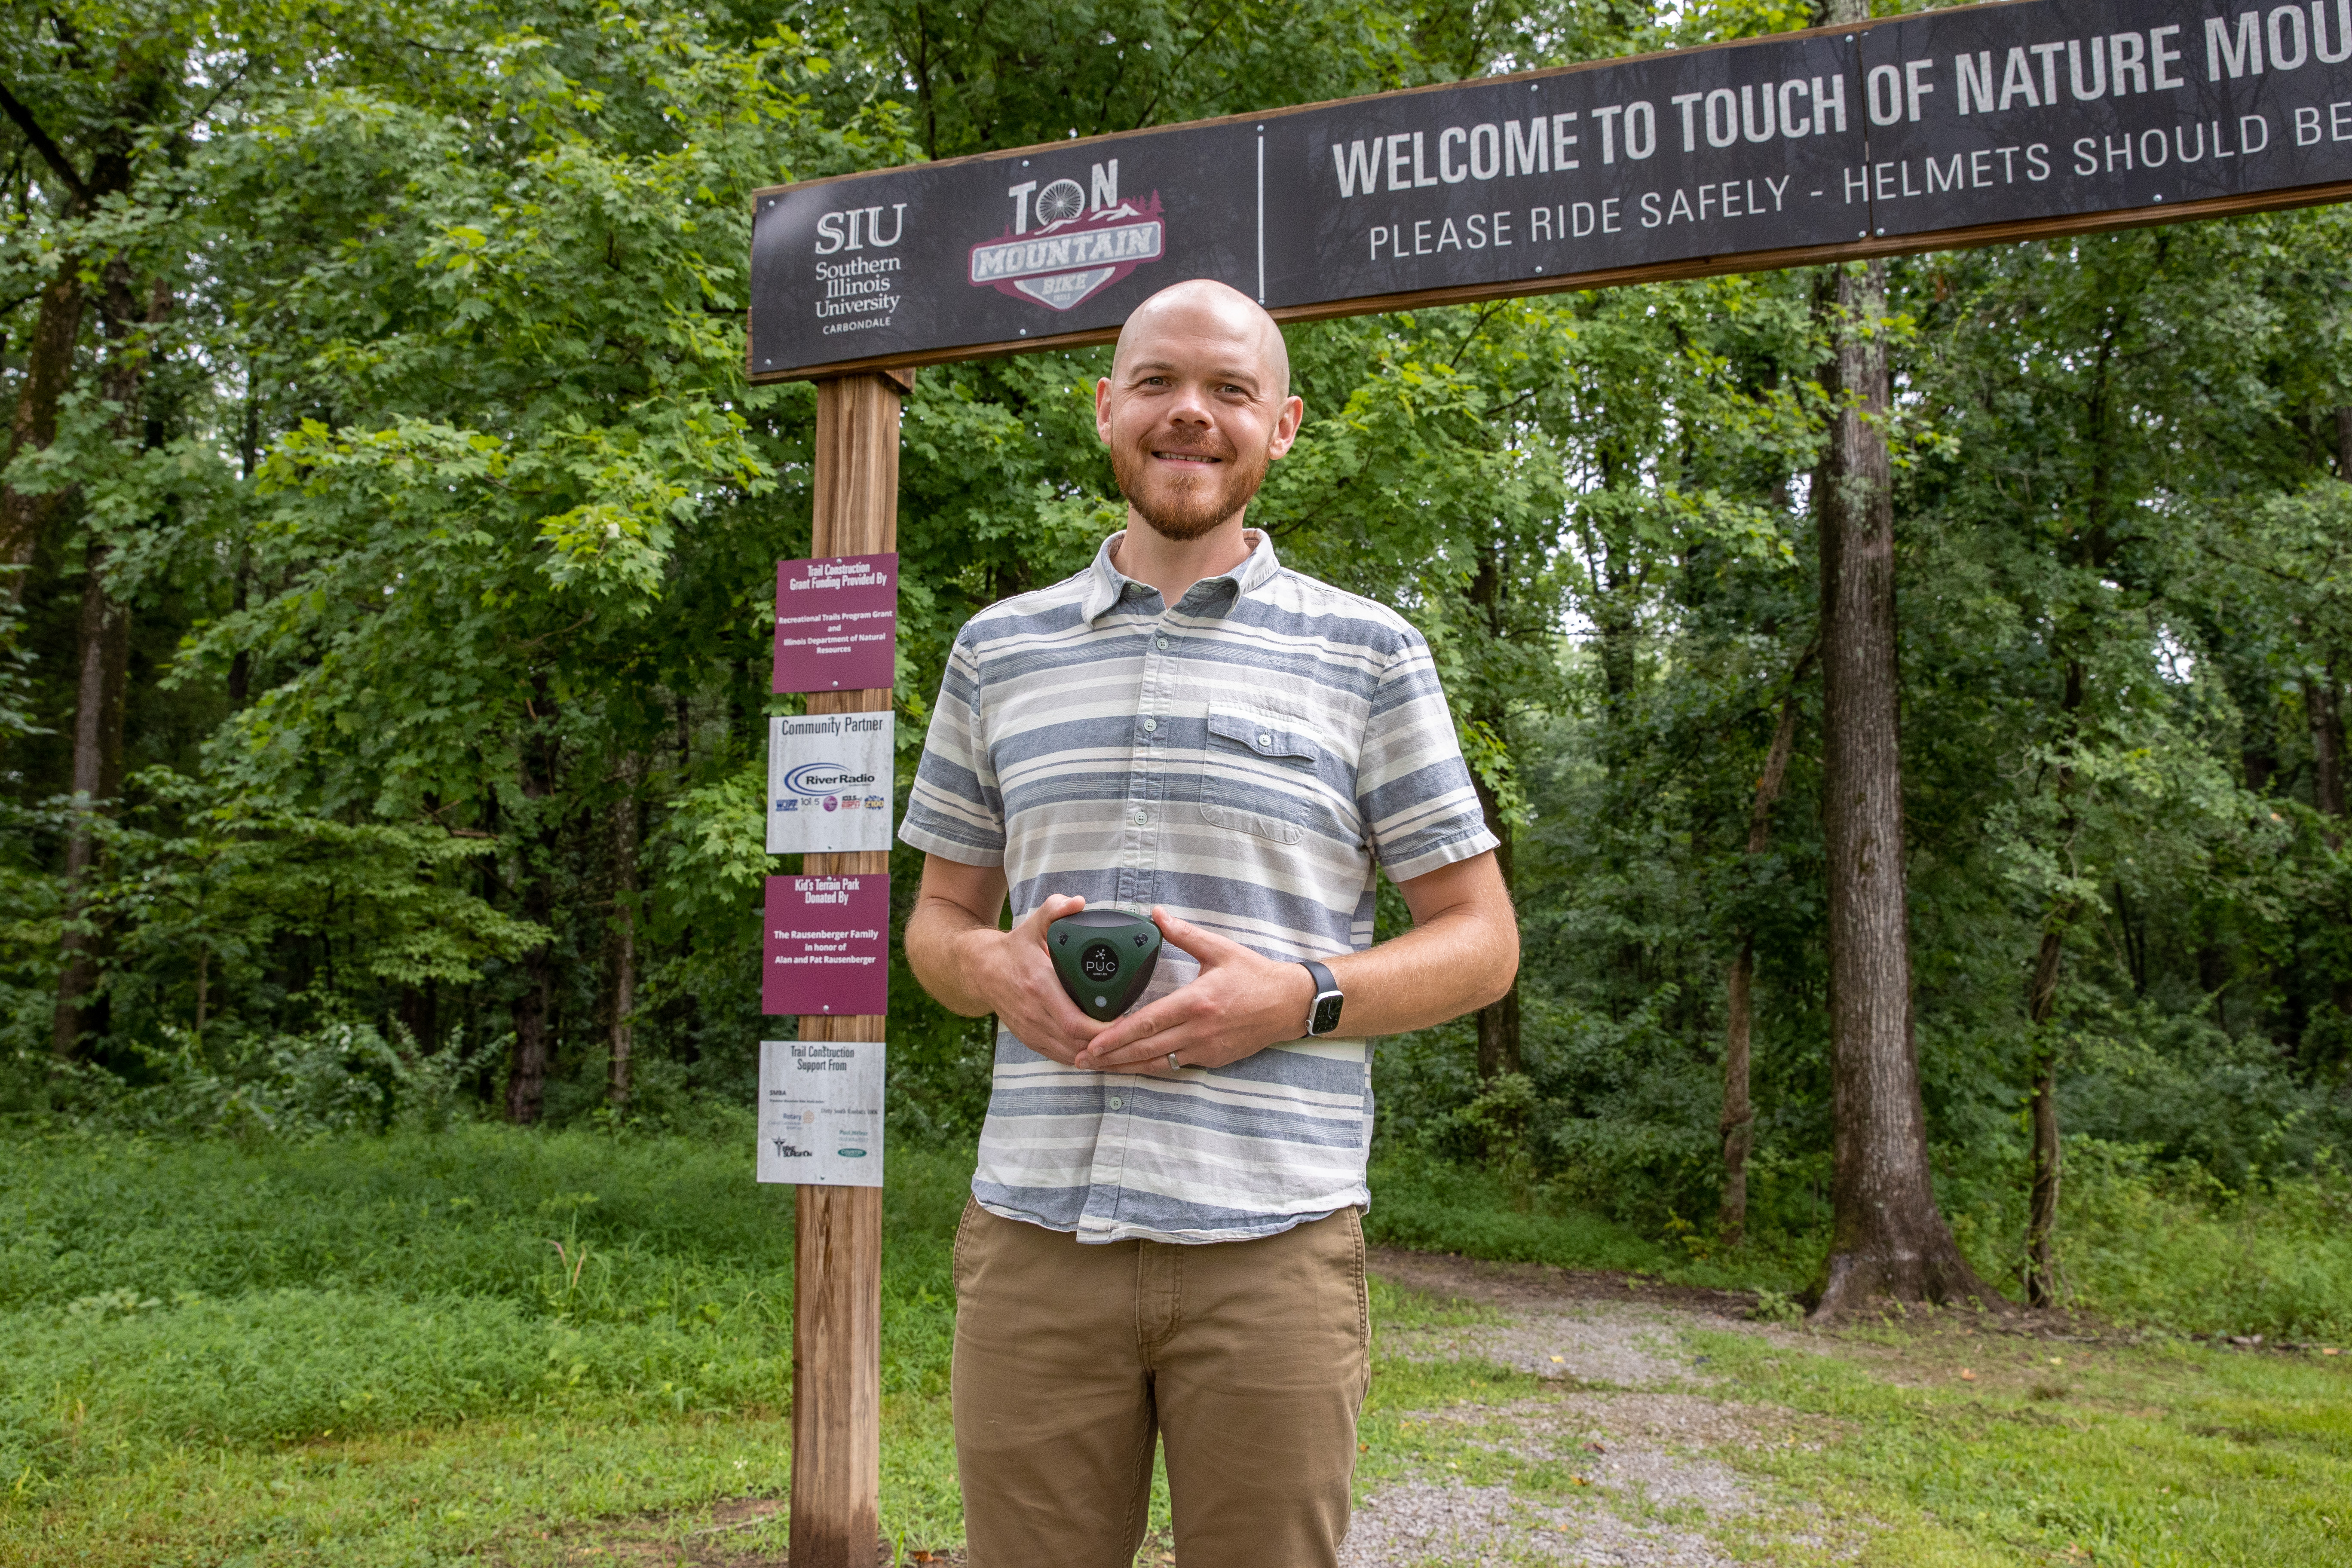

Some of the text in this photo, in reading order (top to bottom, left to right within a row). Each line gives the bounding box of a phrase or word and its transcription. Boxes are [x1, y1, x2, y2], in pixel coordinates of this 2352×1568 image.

[1332, 0, 2352, 198] WELCOME TO TOUCH OF NATURE MOU
[1370, 211, 1512, 260] PLEASE
[1531, 197, 1622, 242] RIDE
[1640, 175, 1790, 229] SAFELY
[1844, 143, 2051, 204] HELMETS
[2073, 114, 2268, 176] SHOULD
[2294, 101, 2352, 146] BE
[815, 203, 907, 254] SIU
[977, 227, 1153, 277] MOUNTAIN
[815, 256, 901, 280] Southern
[826, 274, 891, 298] Illinois
[1042, 273, 1088, 295] BIKE
[815, 293, 900, 318] University
[823, 316, 891, 334] CARBONDALE
[807, 562, 870, 577] Trail Construction
[790, 572, 887, 591] Grant Funding Provided By
[778, 615, 821, 624] Recreational
[842, 612, 871, 621] Program
[784, 638, 806, 646] Illinois
[807, 636, 849, 645] Department
[859, 632, 886, 641] Natural
[782, 717, 883, 736] Community Partner
[795, 878, 860, 891] Kid's Terrain Park
[805, 891, 849, 906] Donated By
[774, 929, 879, 940] The Rausenberger Family
[814, 943, 837, 951] honor
[838, 943, 847, 951] of
[775, 955, 876, 965] Alan and Pat Rausenberger
[1087, 961, 1115, 971] PUC
[791, 1045, 854, 1058] Trail Construction
[797, 1058, 847, 1073] Support From
